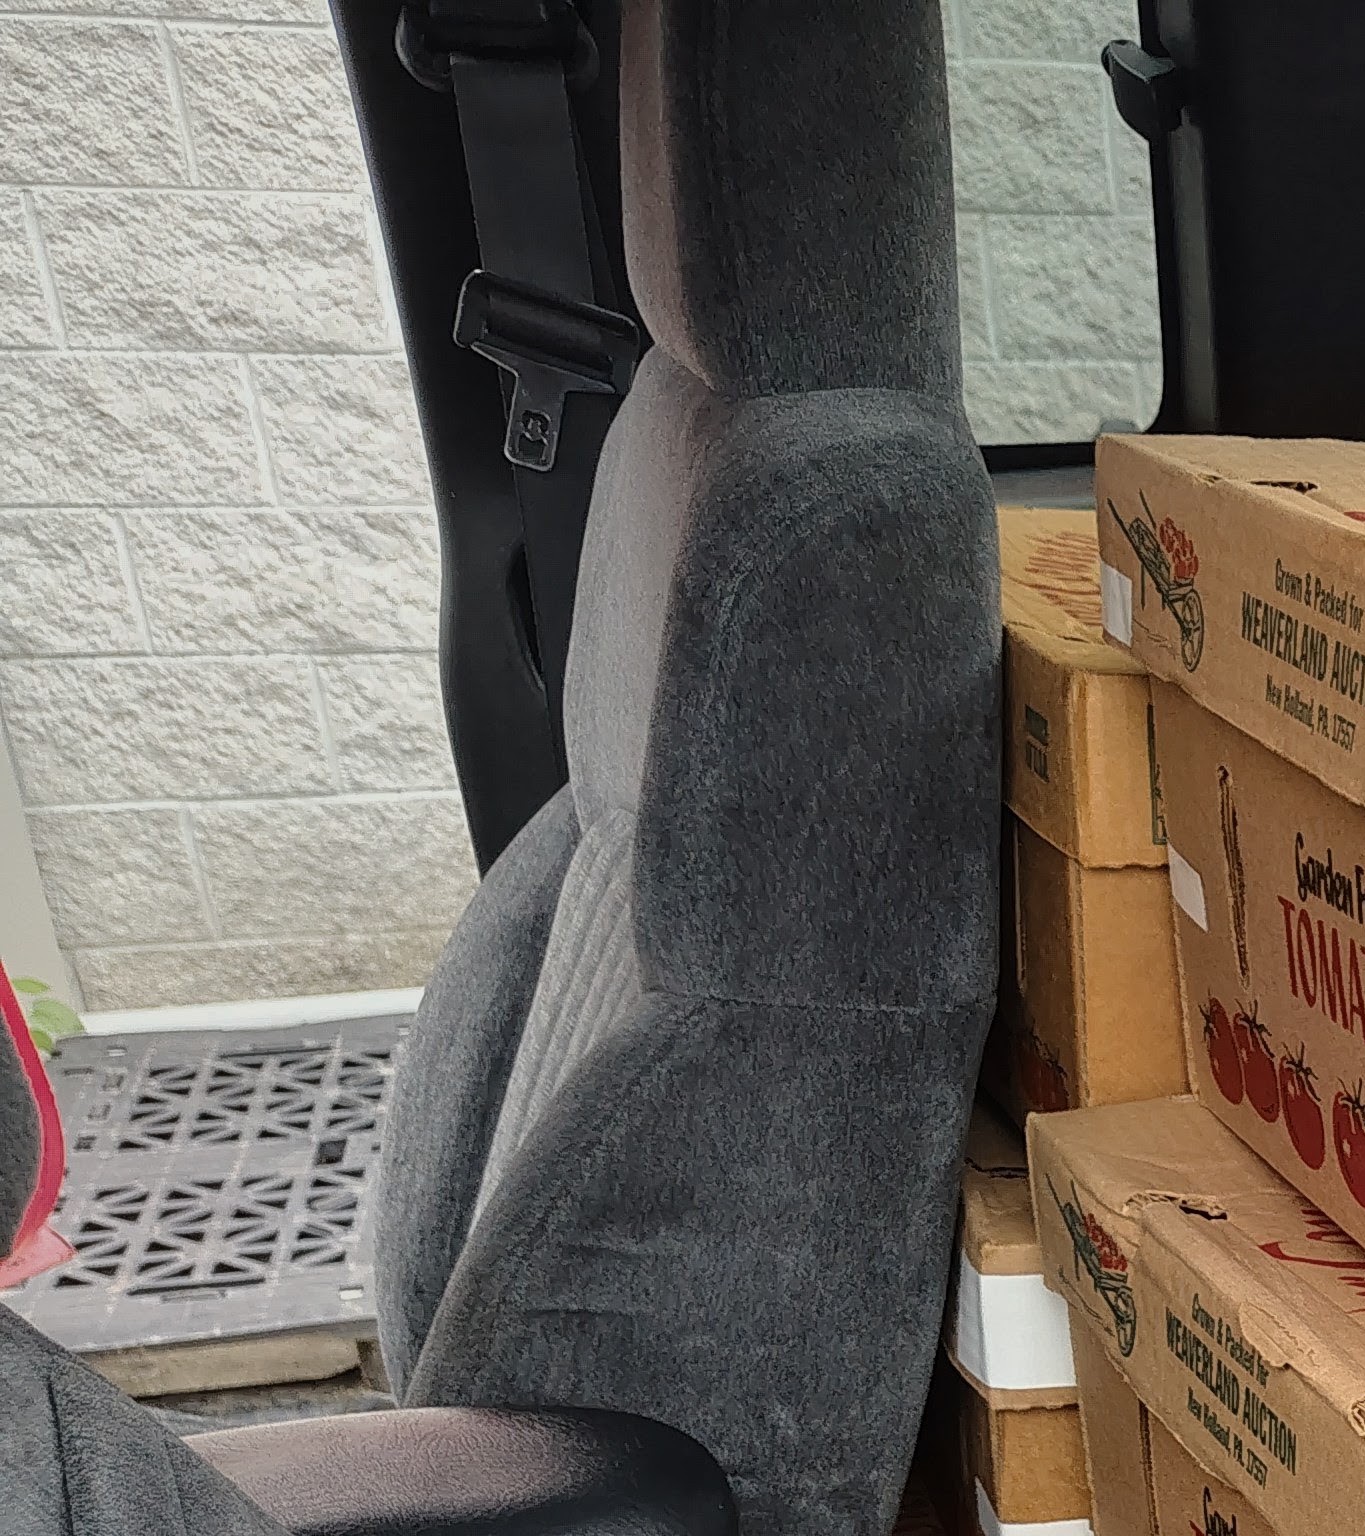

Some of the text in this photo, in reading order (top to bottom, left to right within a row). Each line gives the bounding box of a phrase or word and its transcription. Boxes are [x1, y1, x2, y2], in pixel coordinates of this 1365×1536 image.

[1304, 572, 1311, 607] &
[1241, 591, 1329, 682] WEAVERLAND
[1295, 831, 1354, 920] Garden
[1165, 1305, 1297, 1477] WEAVERLAND AUCTION
